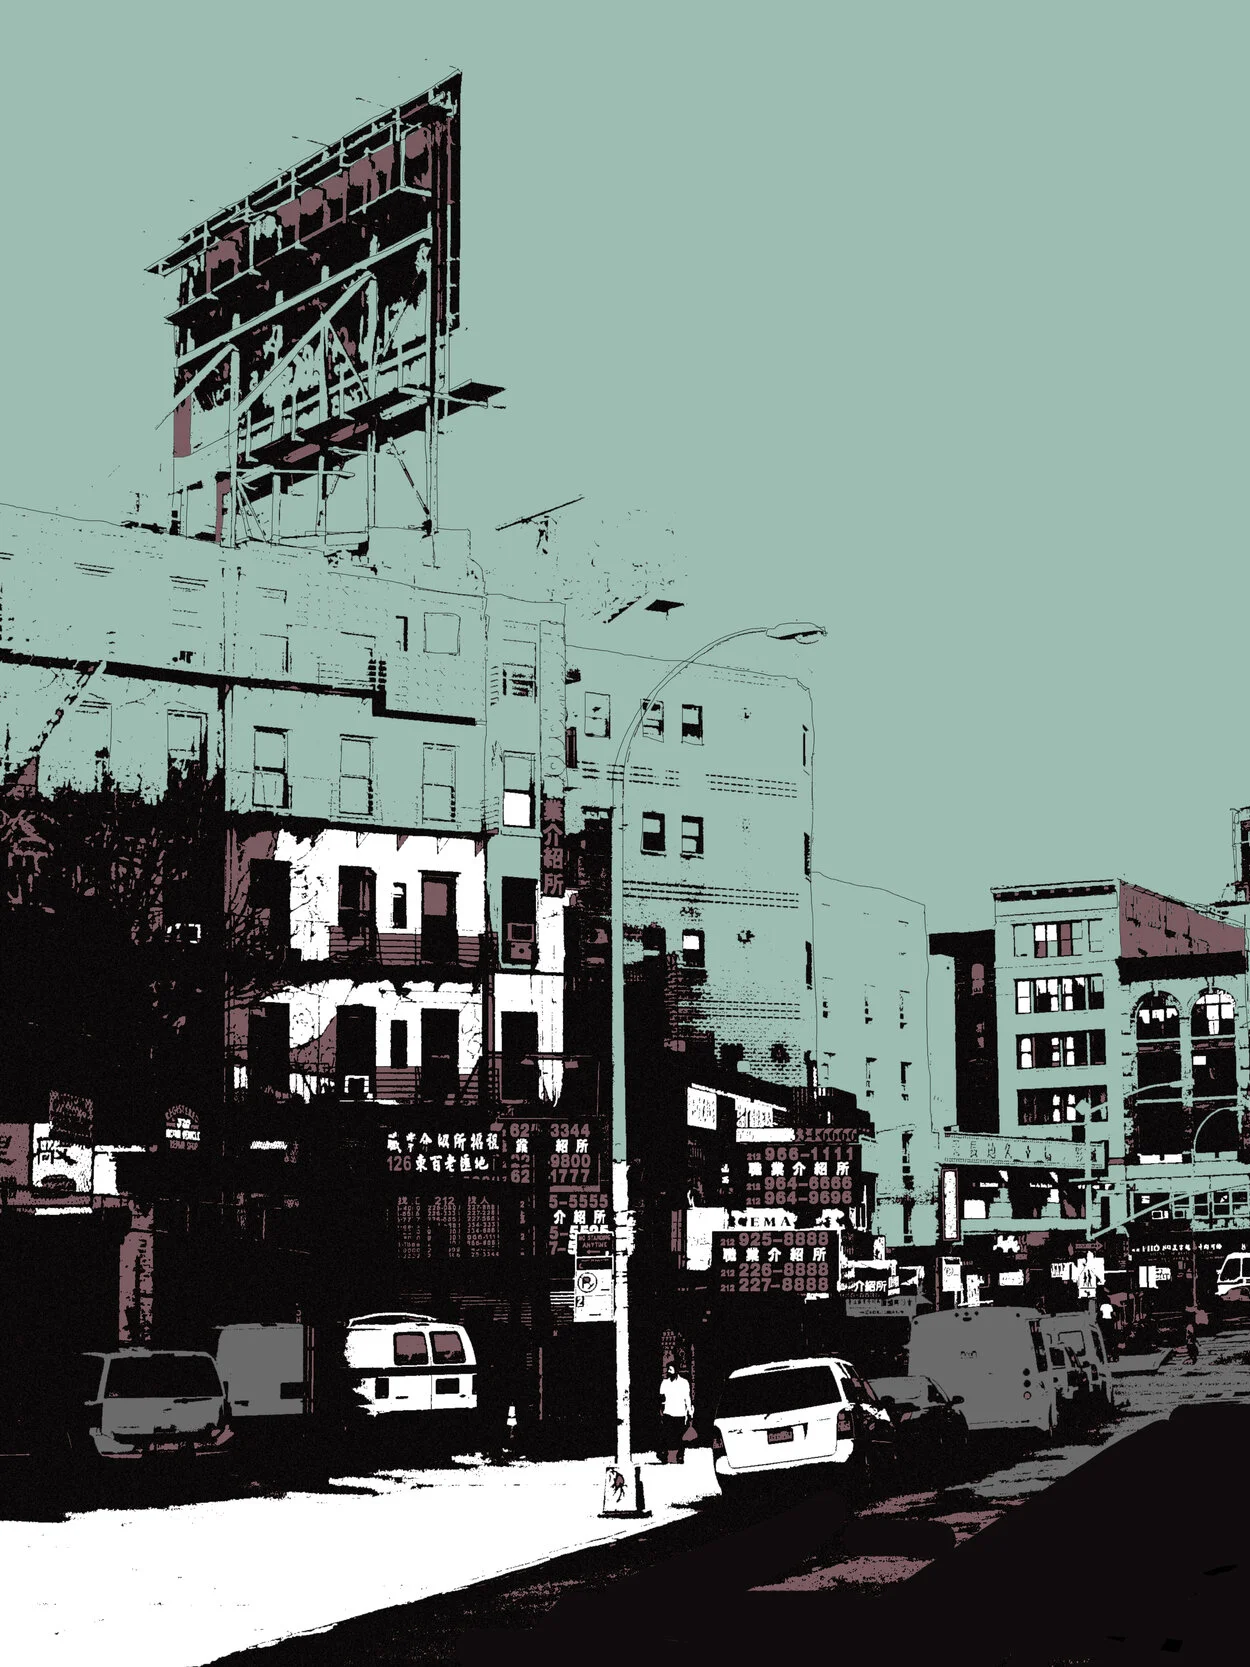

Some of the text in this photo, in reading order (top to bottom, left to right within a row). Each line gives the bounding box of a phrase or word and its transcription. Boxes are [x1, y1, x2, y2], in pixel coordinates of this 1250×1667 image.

[550, 1154, 591, 1168] 9800
[764, 1147, 853, 1161] 966-1111
[387, 1156, 412, 1172] 126
[550, 1169, 590, 1183] 1777
[764, 1176, 853, 1190] 964-6666
[549, 1194, 609, 1209] 5-5555
[764, 1191, 853, 1205] 964-9696
[738, 1232, 829, 1247] 925-8888
[738, 1262, 829, 1277] 226-8888
[738, 1277, 829, 1292] 227-8888
